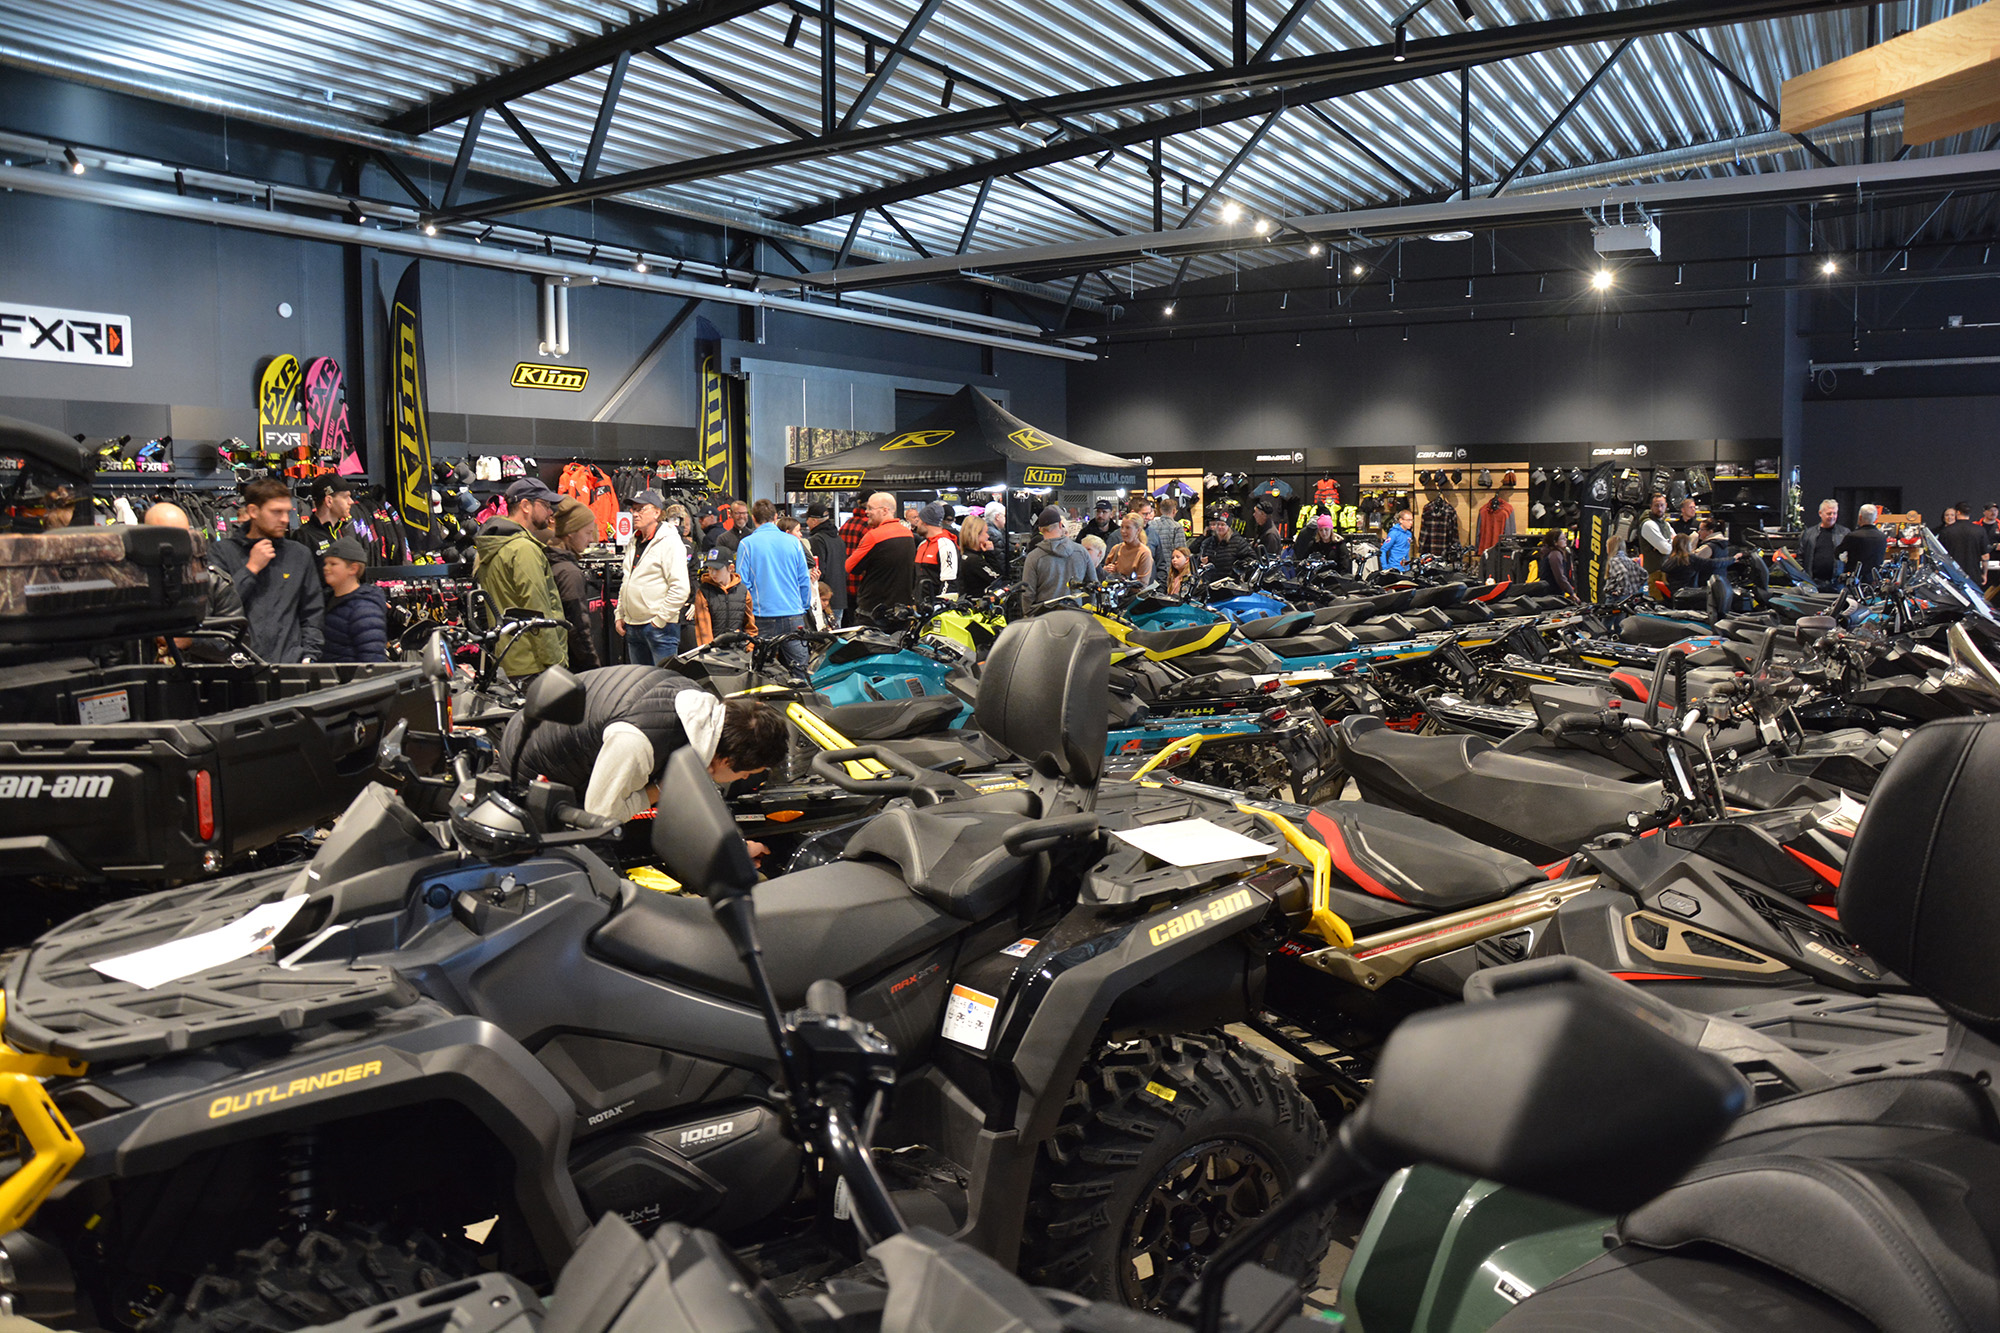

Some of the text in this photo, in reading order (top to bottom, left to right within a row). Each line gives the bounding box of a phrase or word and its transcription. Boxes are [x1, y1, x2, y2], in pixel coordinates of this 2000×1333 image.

[0, 313, 103, 355] FXR
[516, 367, 582, 388] Klim
[399, 322, 430, 515] Klim
[265, 432, 301, 446] FXR
[1015, 430, 1048, 449] K
[808, 469, 982, 486] Klim www.KLIM.com
[1027, 468, 1136, 485] Klim www.KLIM.com
[1589, 514, 1602, 604] can-am
[1148, 889, 1253, 947] can-am
[1805, 941, 1848, 966] 850
[890, 974, 918, 994] MAX
[208, 1059, 383, 1119] OUTLANDER
[588, 1105, 623, 1126] ROTAX
[680, 1121, 734, 1144] 1000
